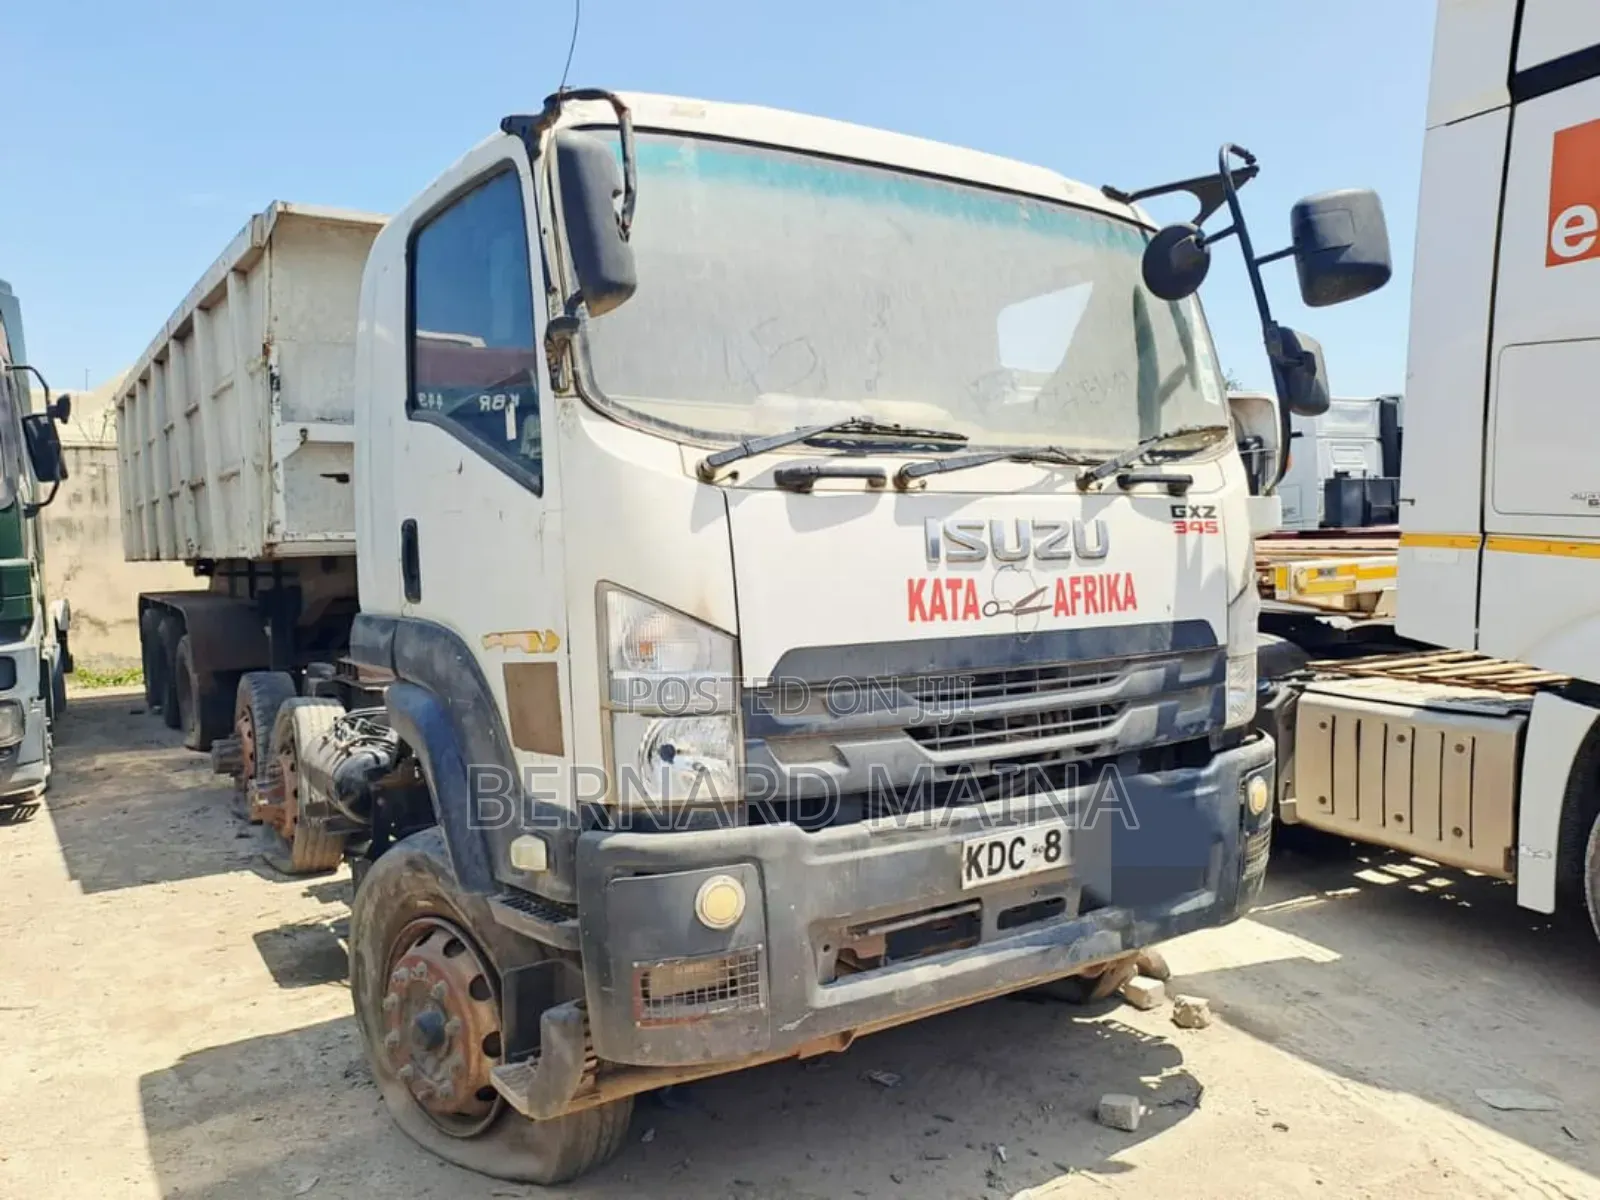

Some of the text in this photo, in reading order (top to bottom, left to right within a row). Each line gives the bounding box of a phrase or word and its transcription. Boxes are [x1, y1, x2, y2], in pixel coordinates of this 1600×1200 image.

[1551, 204, 1598, 258] e
[1170, 505, 1217, 519] GXZ
[1173, 520, 1219, 535] 345
[924, 516, 1110, 563] ISUZU
[907, 572, 1137, 622] KATA AFRIKA
[966, 836, 1026, 881] KDC
